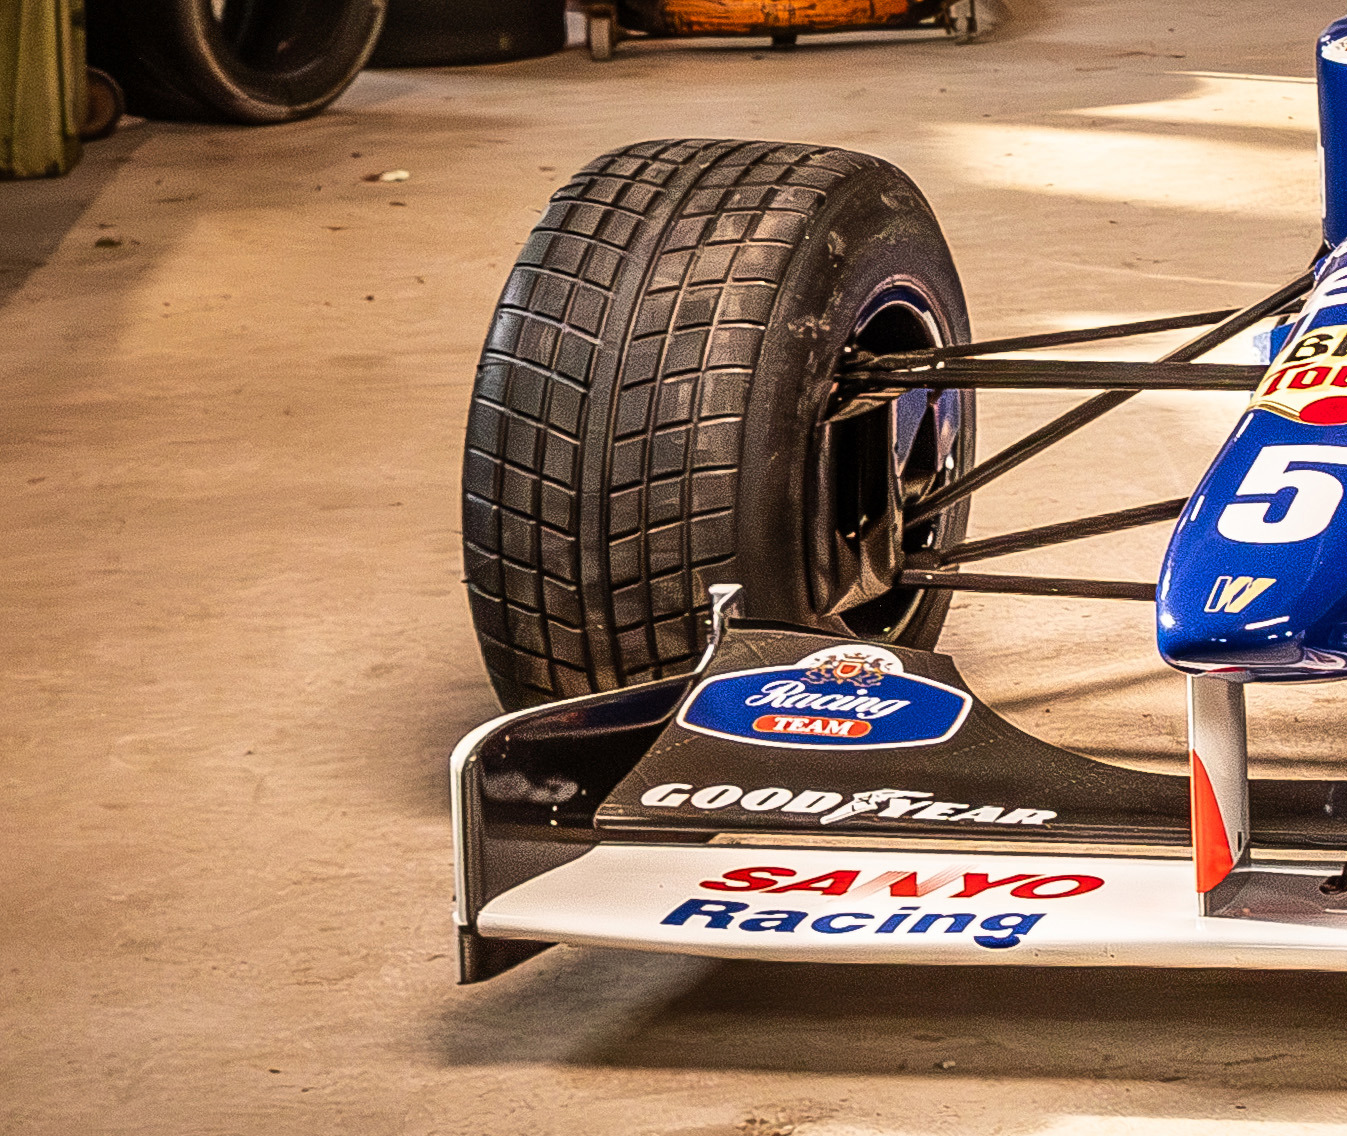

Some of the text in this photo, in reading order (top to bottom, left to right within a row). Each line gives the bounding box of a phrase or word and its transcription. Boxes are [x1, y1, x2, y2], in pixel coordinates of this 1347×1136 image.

[745, 679, 911, 720] Racing
[773, 717, 856, 736] TEAM
[698, 865, 1106, 901] SANYO
[660, 897, 1048, 950] Racing
